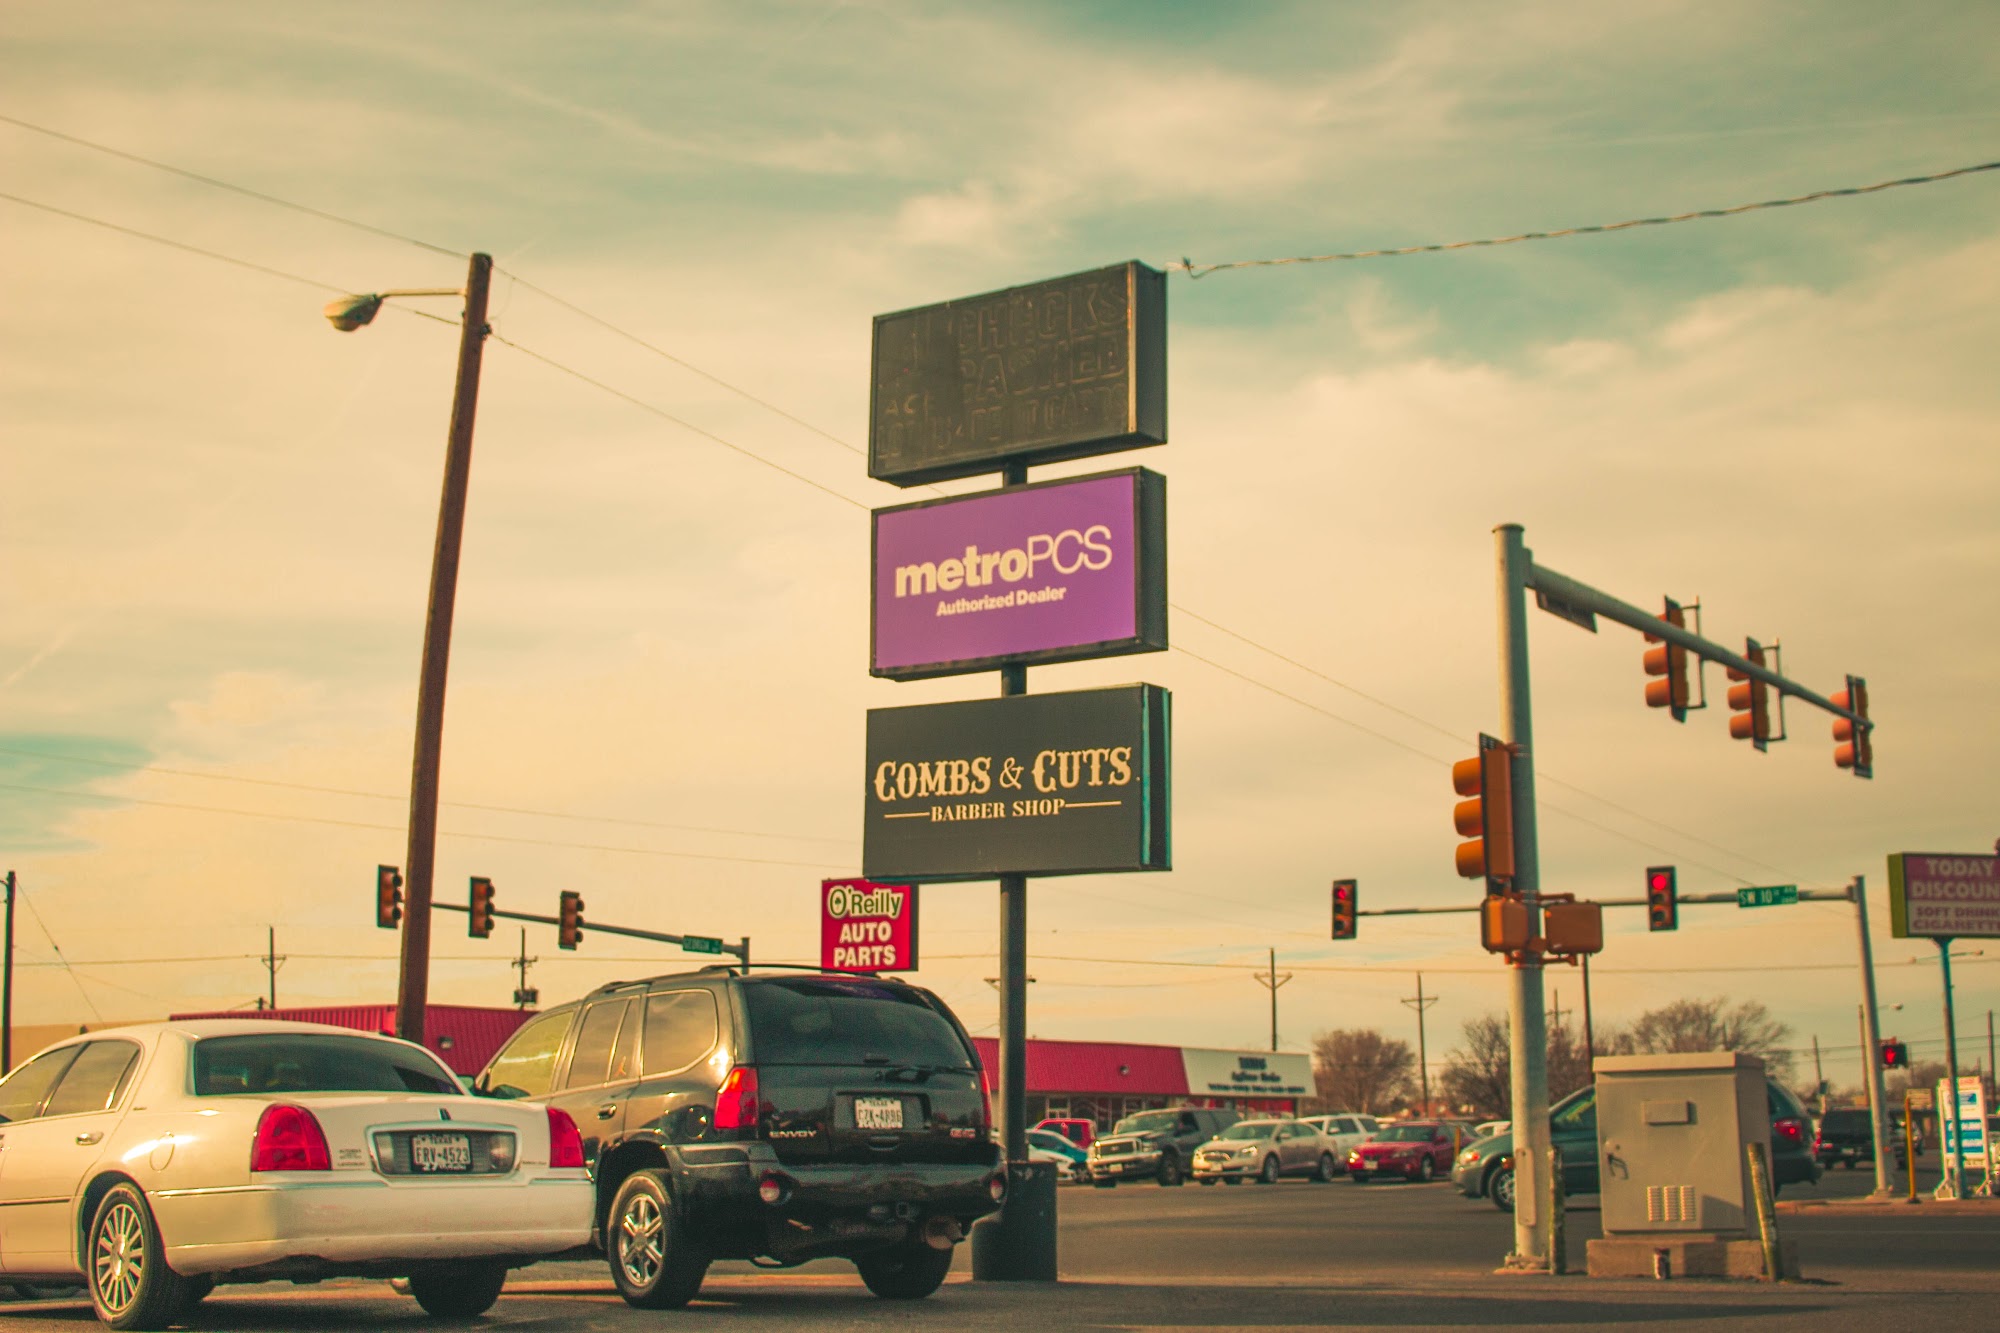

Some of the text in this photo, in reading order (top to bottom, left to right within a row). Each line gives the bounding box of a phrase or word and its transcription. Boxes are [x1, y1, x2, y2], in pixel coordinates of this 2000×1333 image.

[895, 524, 1113, 598] metroPCS
[936, 586, 1067, 616] Authorized Dealer
[873, 746, 1132, 802] COMBS & CUTS
[930, 798, 1066, 822] BARBER SHOP
[828, 886, 902, 918] O'Reilly
[839, 921, 892, 944] AUTO
[833, 944, 896, 967] PARTS
